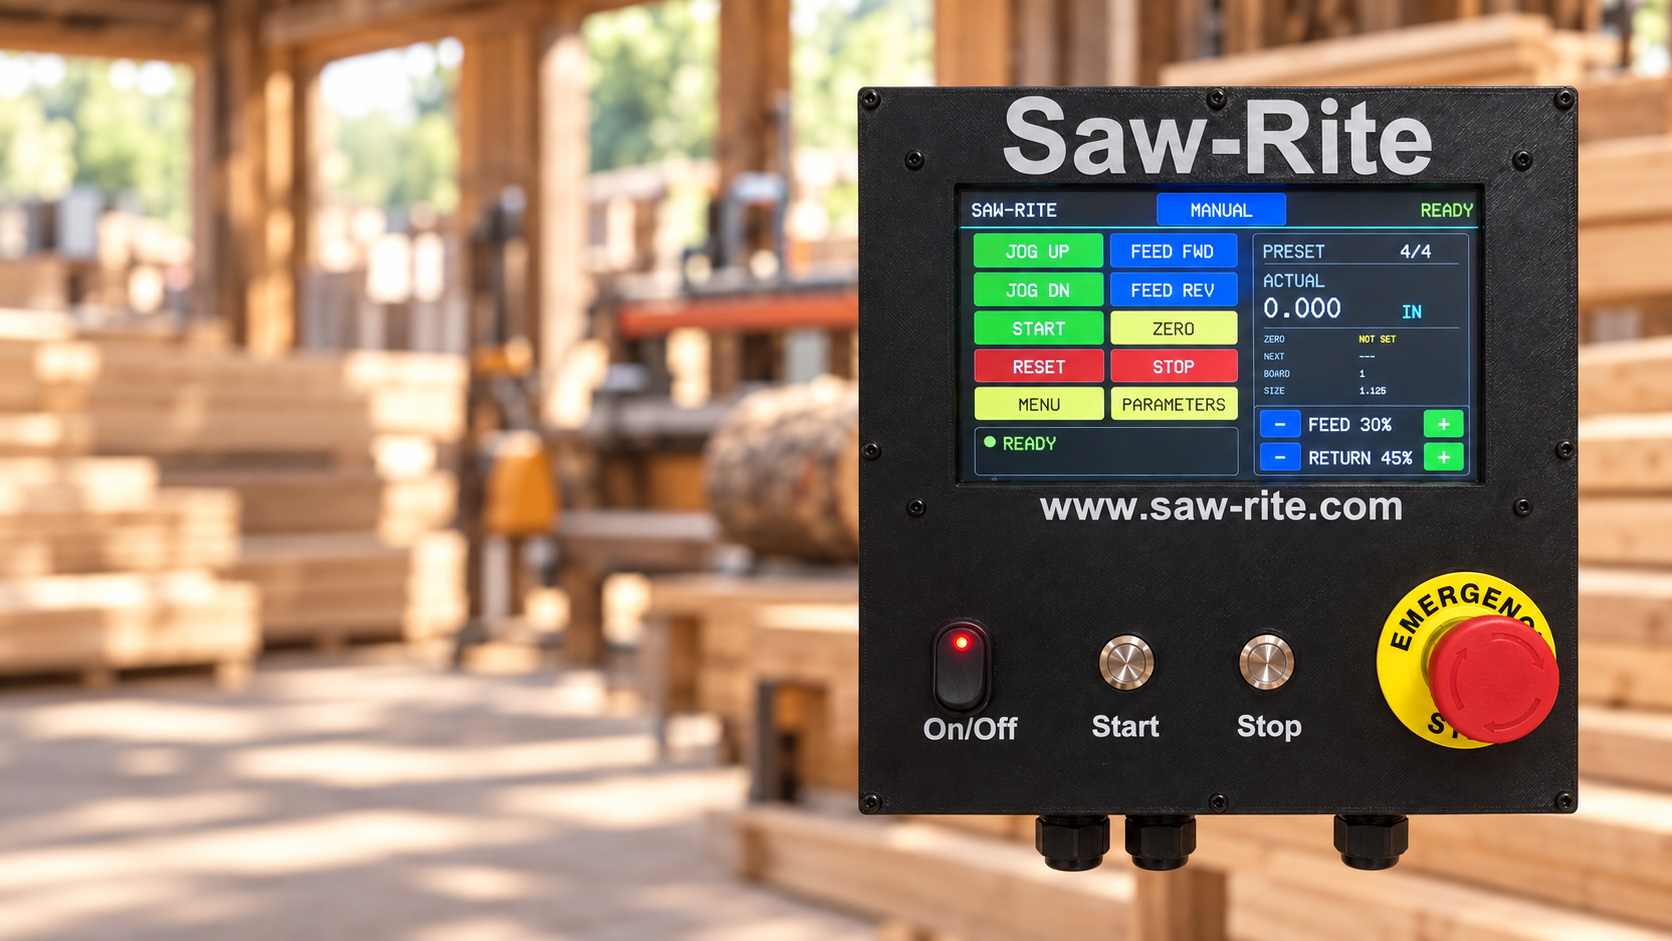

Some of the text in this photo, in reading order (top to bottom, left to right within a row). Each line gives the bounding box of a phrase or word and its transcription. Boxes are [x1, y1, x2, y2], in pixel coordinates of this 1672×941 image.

[1004, 96, 1432, 175] Saw-Rite
[972, 203, 1057, 217] SAW-RITE
[1192, 203, 1252, 217] MANUAL
[1422, 203, 1473, 217] READY
[1006, 244, 1069, 258] JOG UP
[1132, 244, 1213, 258] FEED FWD
[1264, 244, 1325, 258] PRESET
[1401, 244, 1431, 258] 4/4
[1264, 274, 1325, 287] ACTUAL
[1006, 283, 1069, 297] JOG DN
[1132, 283, 1214, 297] FEED REV
[1264, 297, 1340, 318] 0.000
[1403, 305, 1421, 319] IN
[1013, 322, 1065, 335] START
[1153, 322, 1194, 335] ZERO
[1263, 334, 1284, 344] ZERO
[1358, 334, 1396, 344] NOT SET
[1263, 352, 1284, 361] NEXT
[1014, 360, 1065, 374] RESET
[1153, 360, 1194, 373] STOP
[1263, 369, 1290, 378] BOARD
[1359, 369, 1365, 378] 1
[1263, 386, 1284, 395] SIZE
[1359, 386, 1386, 395] 1.125
[1019, 398, 1060, 411] MENU
[1123, 398, 1225, 411] PARAMETERS
[1309, 418, 1392, 431] FEED 30%
[1437, 417, 1451, 431] +
[1004, 436, 1056, 450] READY
[1310, 451, 1412, 465] RETURN 45%
[1437, 450, 1451, 464] +
[1040, 490, 1402, 520] www.saw-rite.com
[1390, 583, 1542, 652] EMERGEN
[924, 717, 1018, 740] On/Off
[1092, 715, 1159, 737] Start
[1238, 715, 1301, 742] Stop
